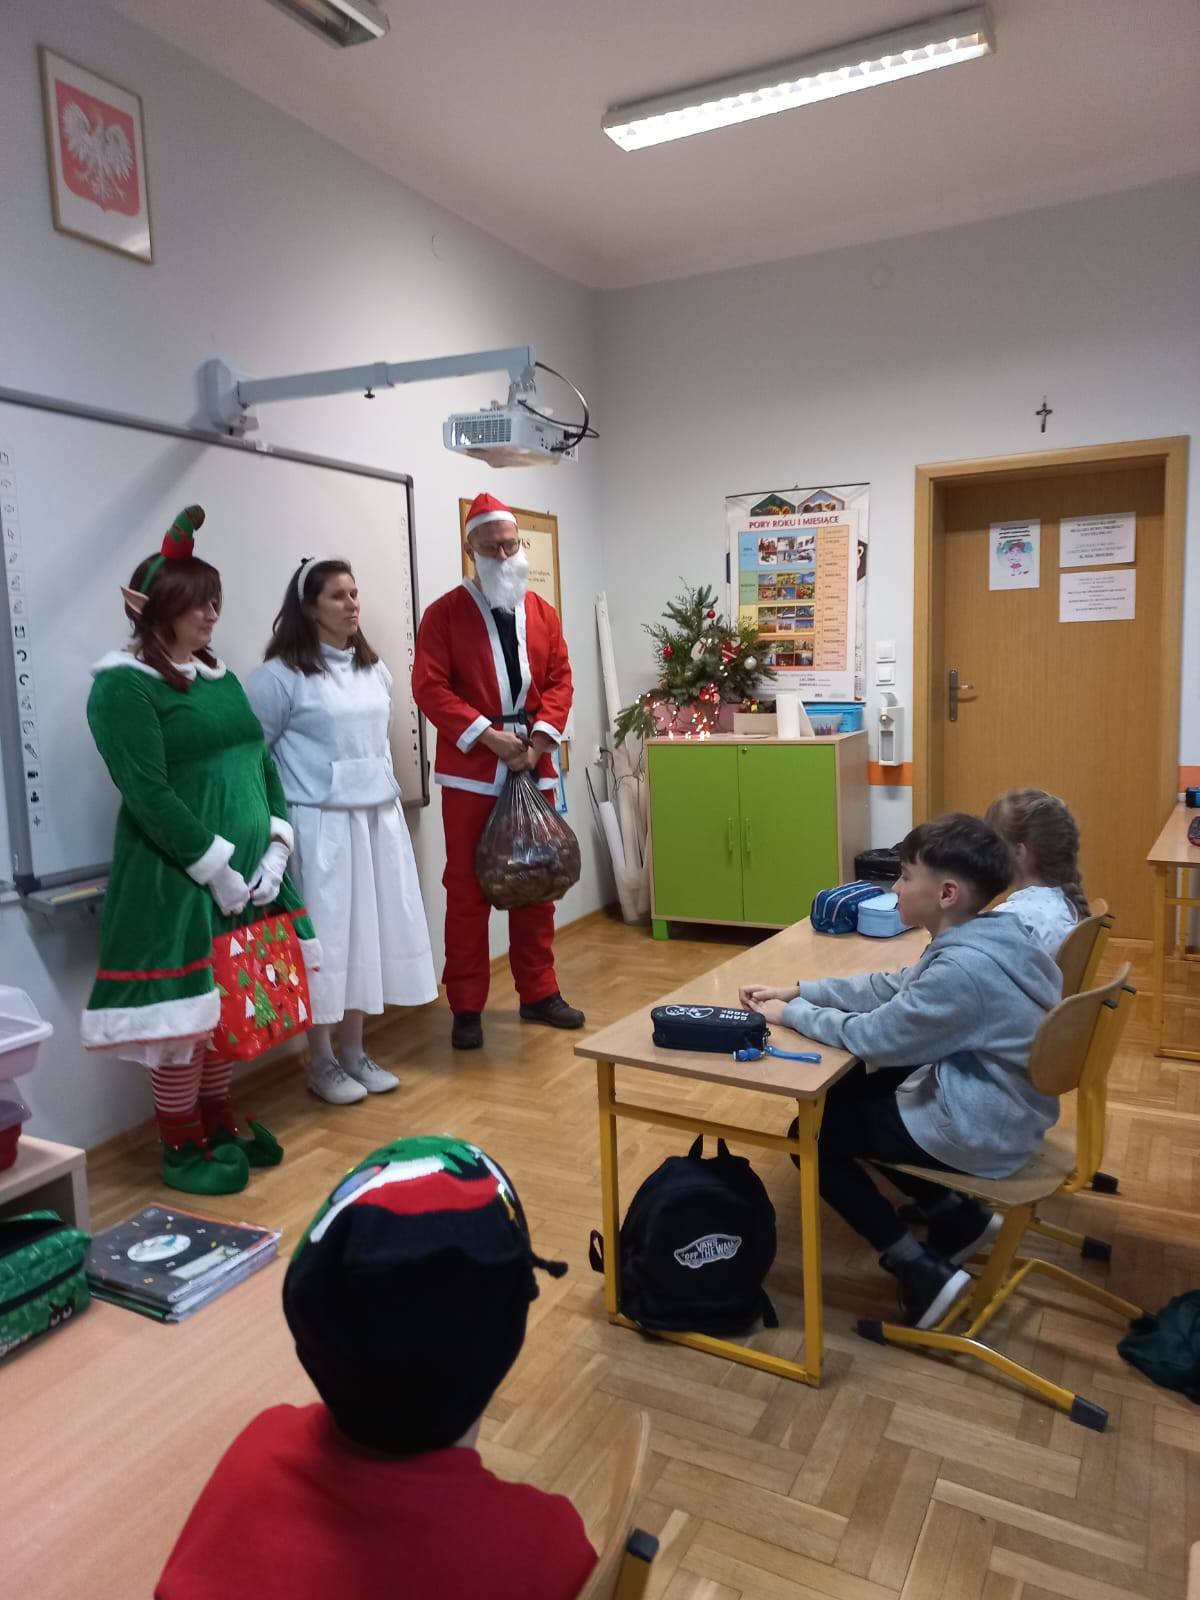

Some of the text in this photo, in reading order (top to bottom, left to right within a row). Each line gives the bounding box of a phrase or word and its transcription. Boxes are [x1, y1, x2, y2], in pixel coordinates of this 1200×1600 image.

[749, 521, 770, 529] PORY
[772, 519, 796, 528] ROKU
[803, 516, 839, 525] MIESIĄCE
